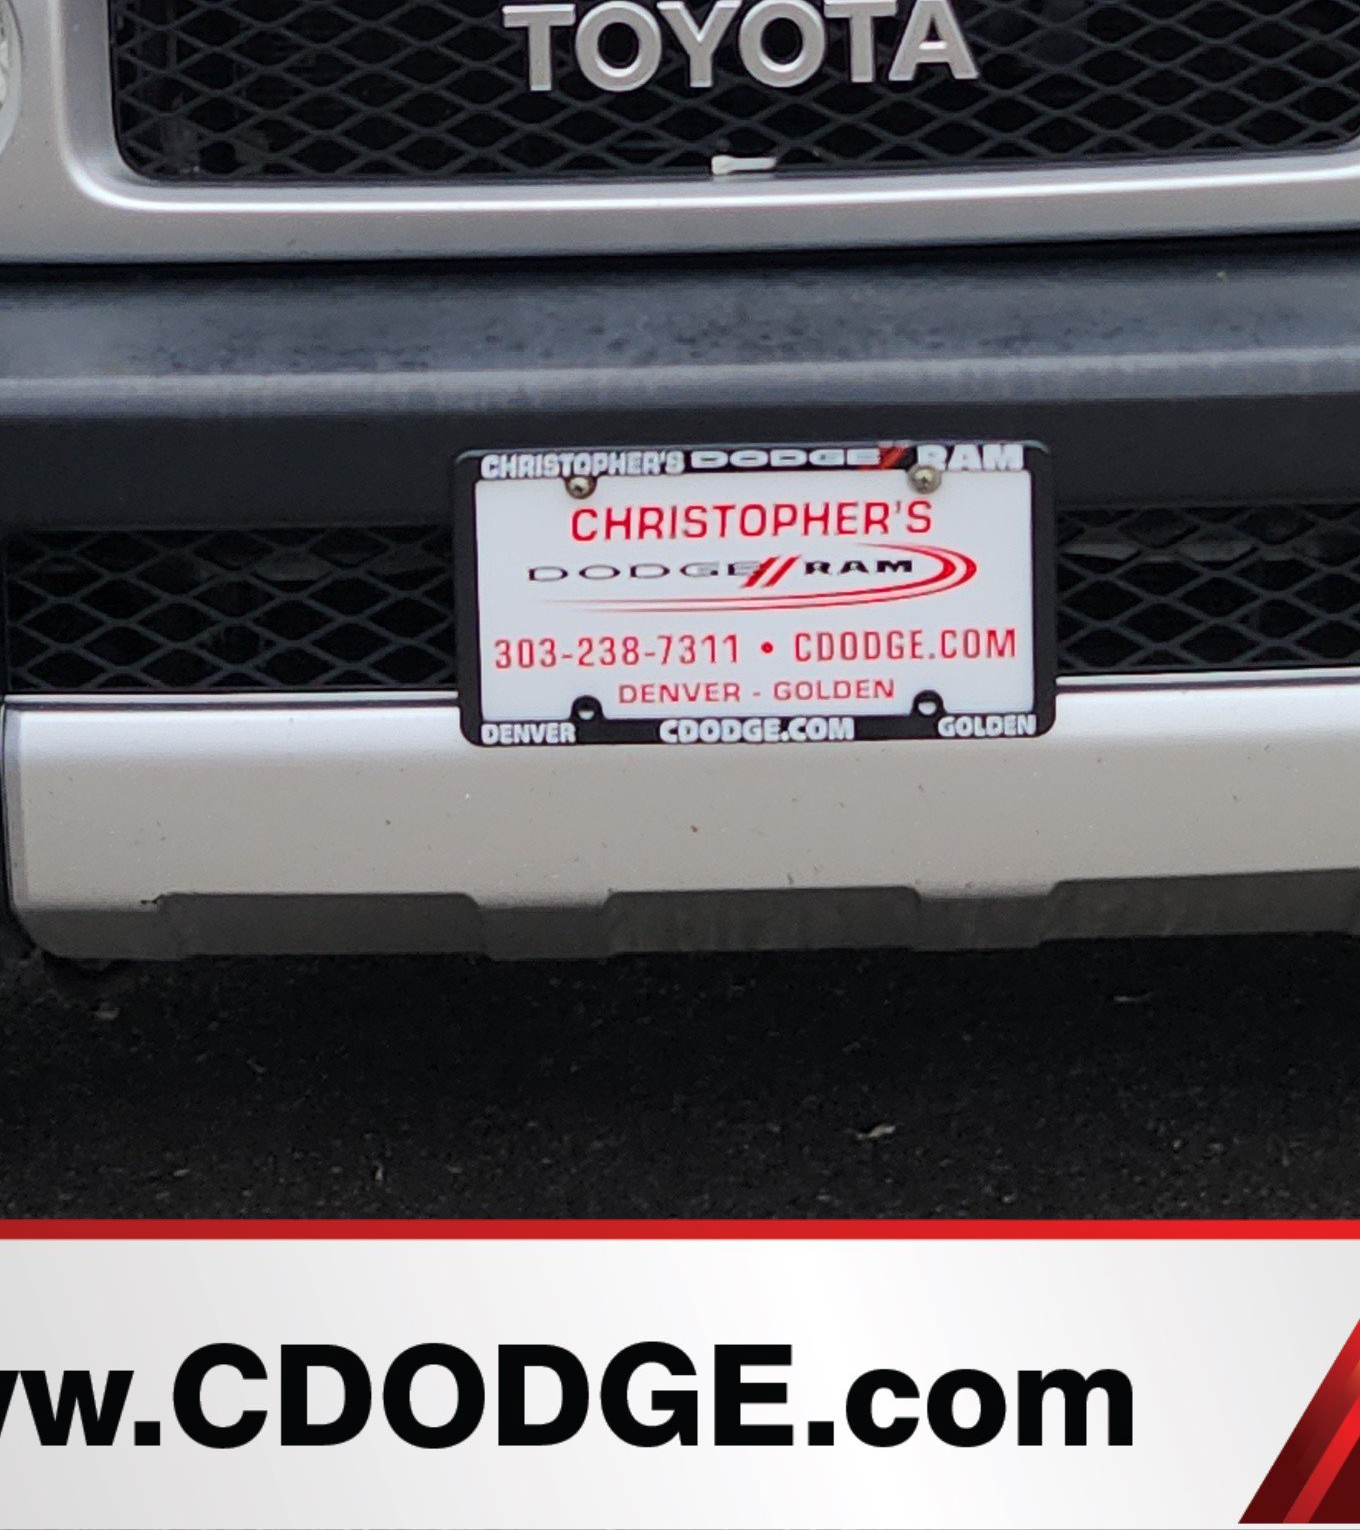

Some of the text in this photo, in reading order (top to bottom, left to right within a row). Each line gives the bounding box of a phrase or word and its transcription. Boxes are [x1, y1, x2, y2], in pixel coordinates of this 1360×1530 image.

[480, 443, 1025, 479] CHRISTOPHER'S DODGE RAM
[570, 500, 933, 542] CHRISTOPHER'S
[527, 559, 914, 583] DODGE RAM
[493, 628, 1017, 670] 303-238-7311 CDODGE.COM
[618, 682, 741, 705] DENVER
[773, 678, 895, 701] GOLDEN
[480, 713, 1038, 746] DENVER CDODGE.COM GOLDEN
